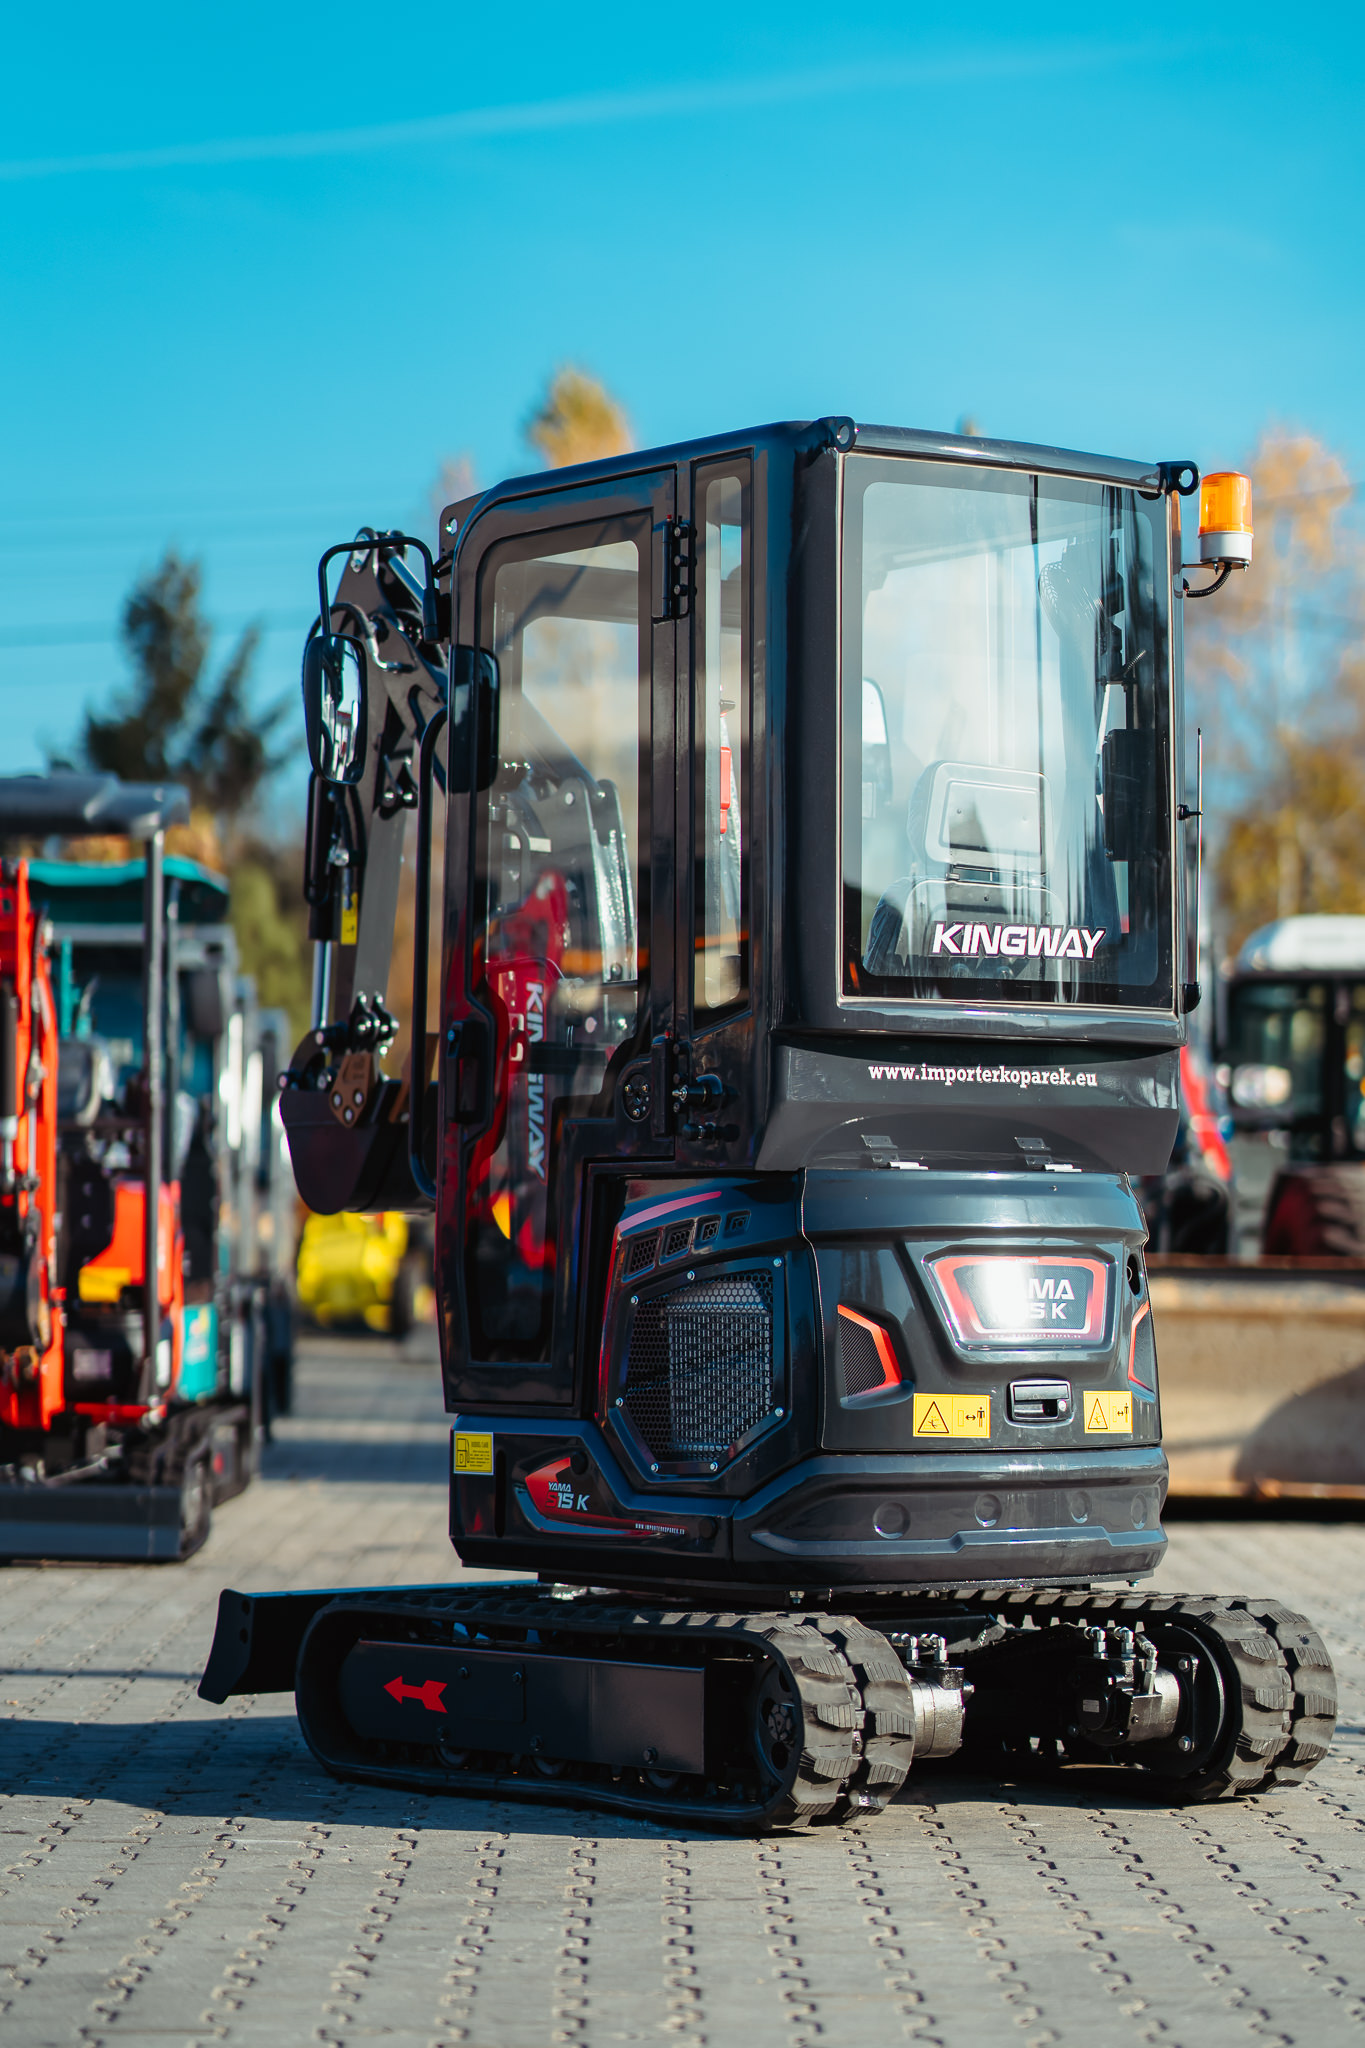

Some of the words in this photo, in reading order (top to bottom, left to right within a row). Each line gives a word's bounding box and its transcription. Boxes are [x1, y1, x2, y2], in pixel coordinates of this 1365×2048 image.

[931, 922, 1105, 959] KINGWAY
[868, 1063, 1099, 1089] www.importerkoparek.eu
[1051, 1302, 1068, 1320] K
[548, 1482, 573, 1493] YAMA
[576, 1494, 591, 1511] K
